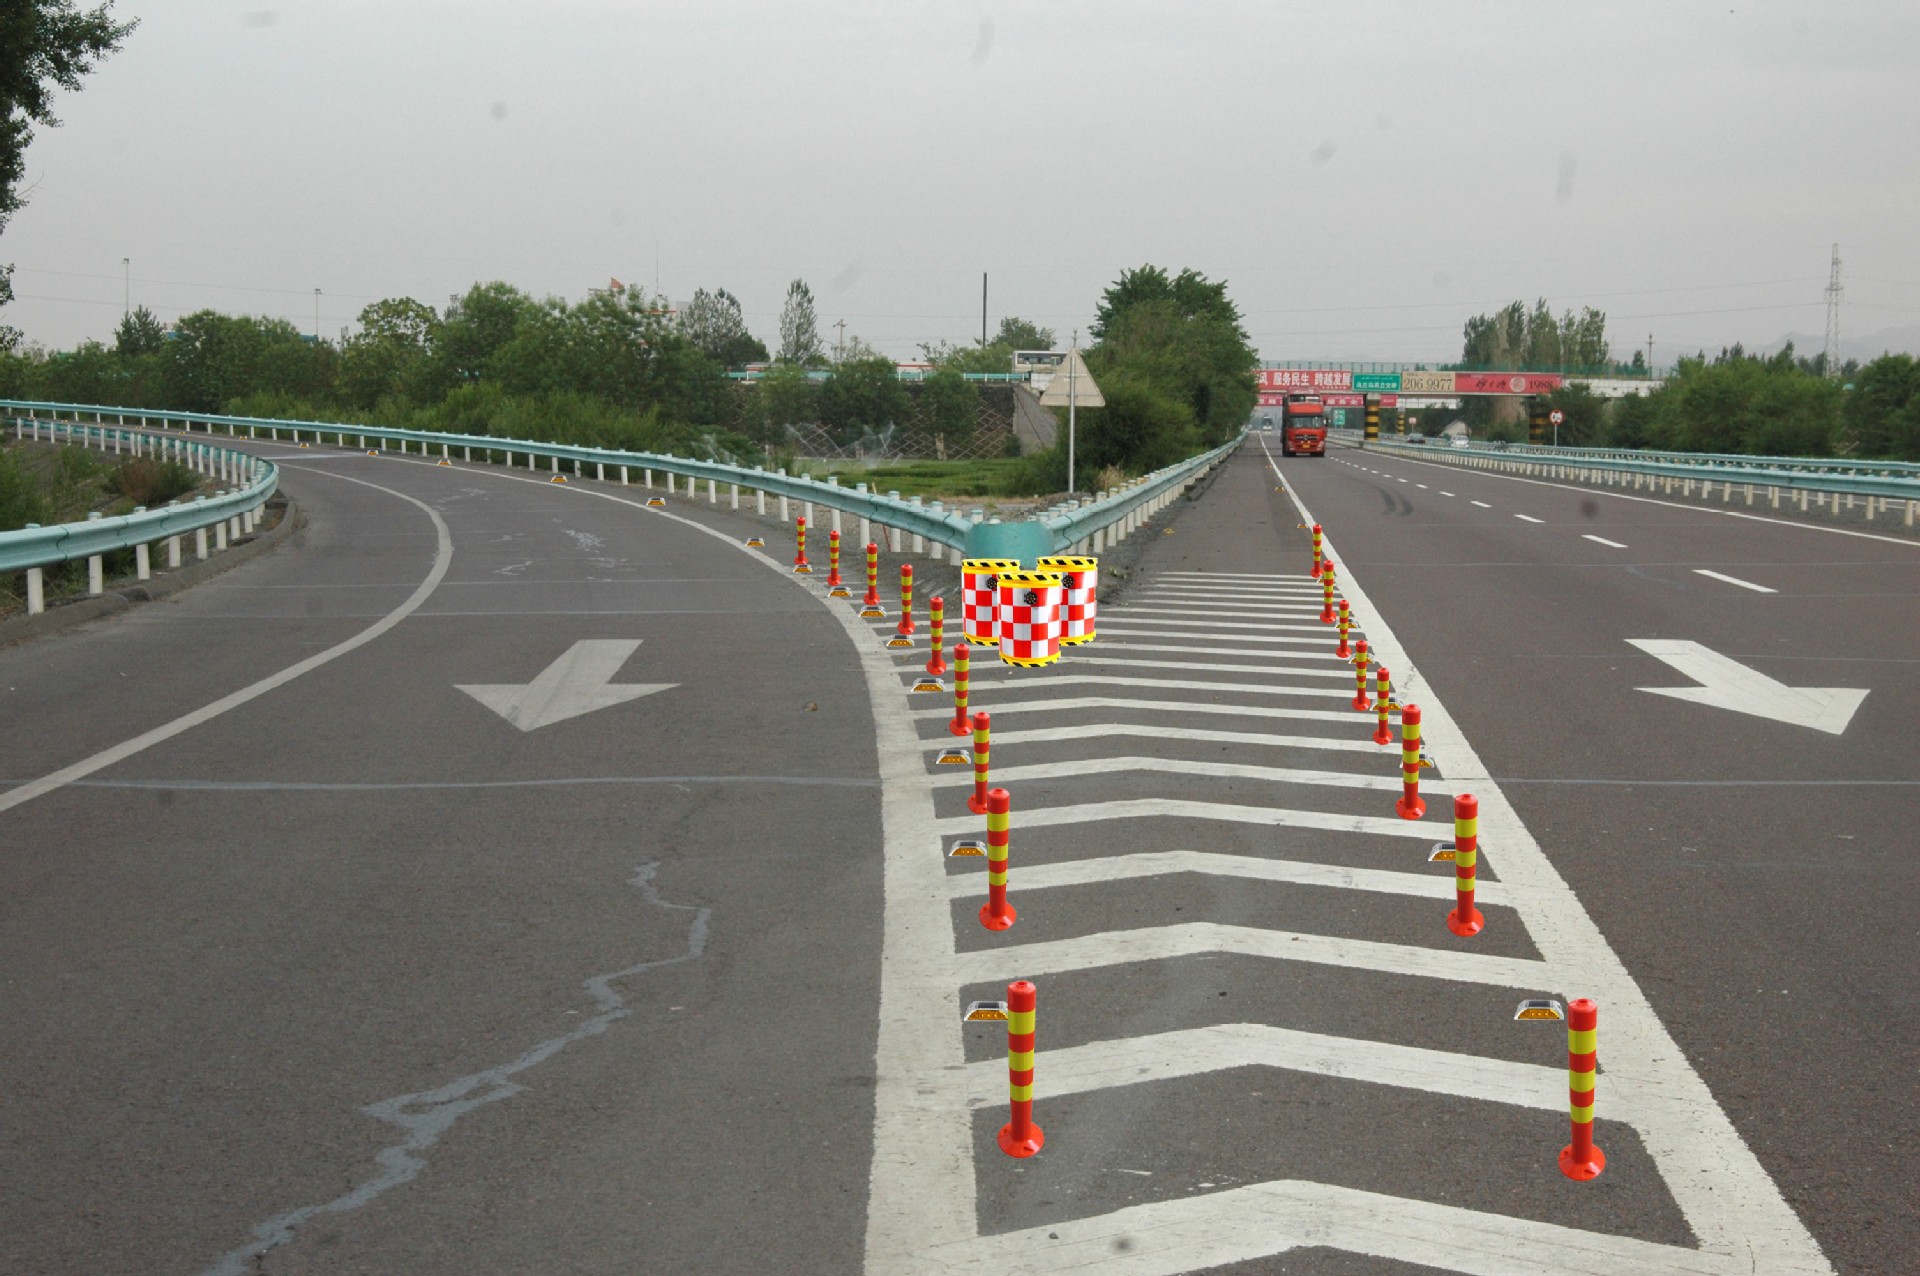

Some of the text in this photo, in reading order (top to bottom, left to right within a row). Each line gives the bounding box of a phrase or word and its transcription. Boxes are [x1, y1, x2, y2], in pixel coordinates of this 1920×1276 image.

[1273, 371, 1310, 386] 服务民生
[1314, 371, 1351, 386] 跨越发展
[1403, 377, 1452, 390] 206 9977
